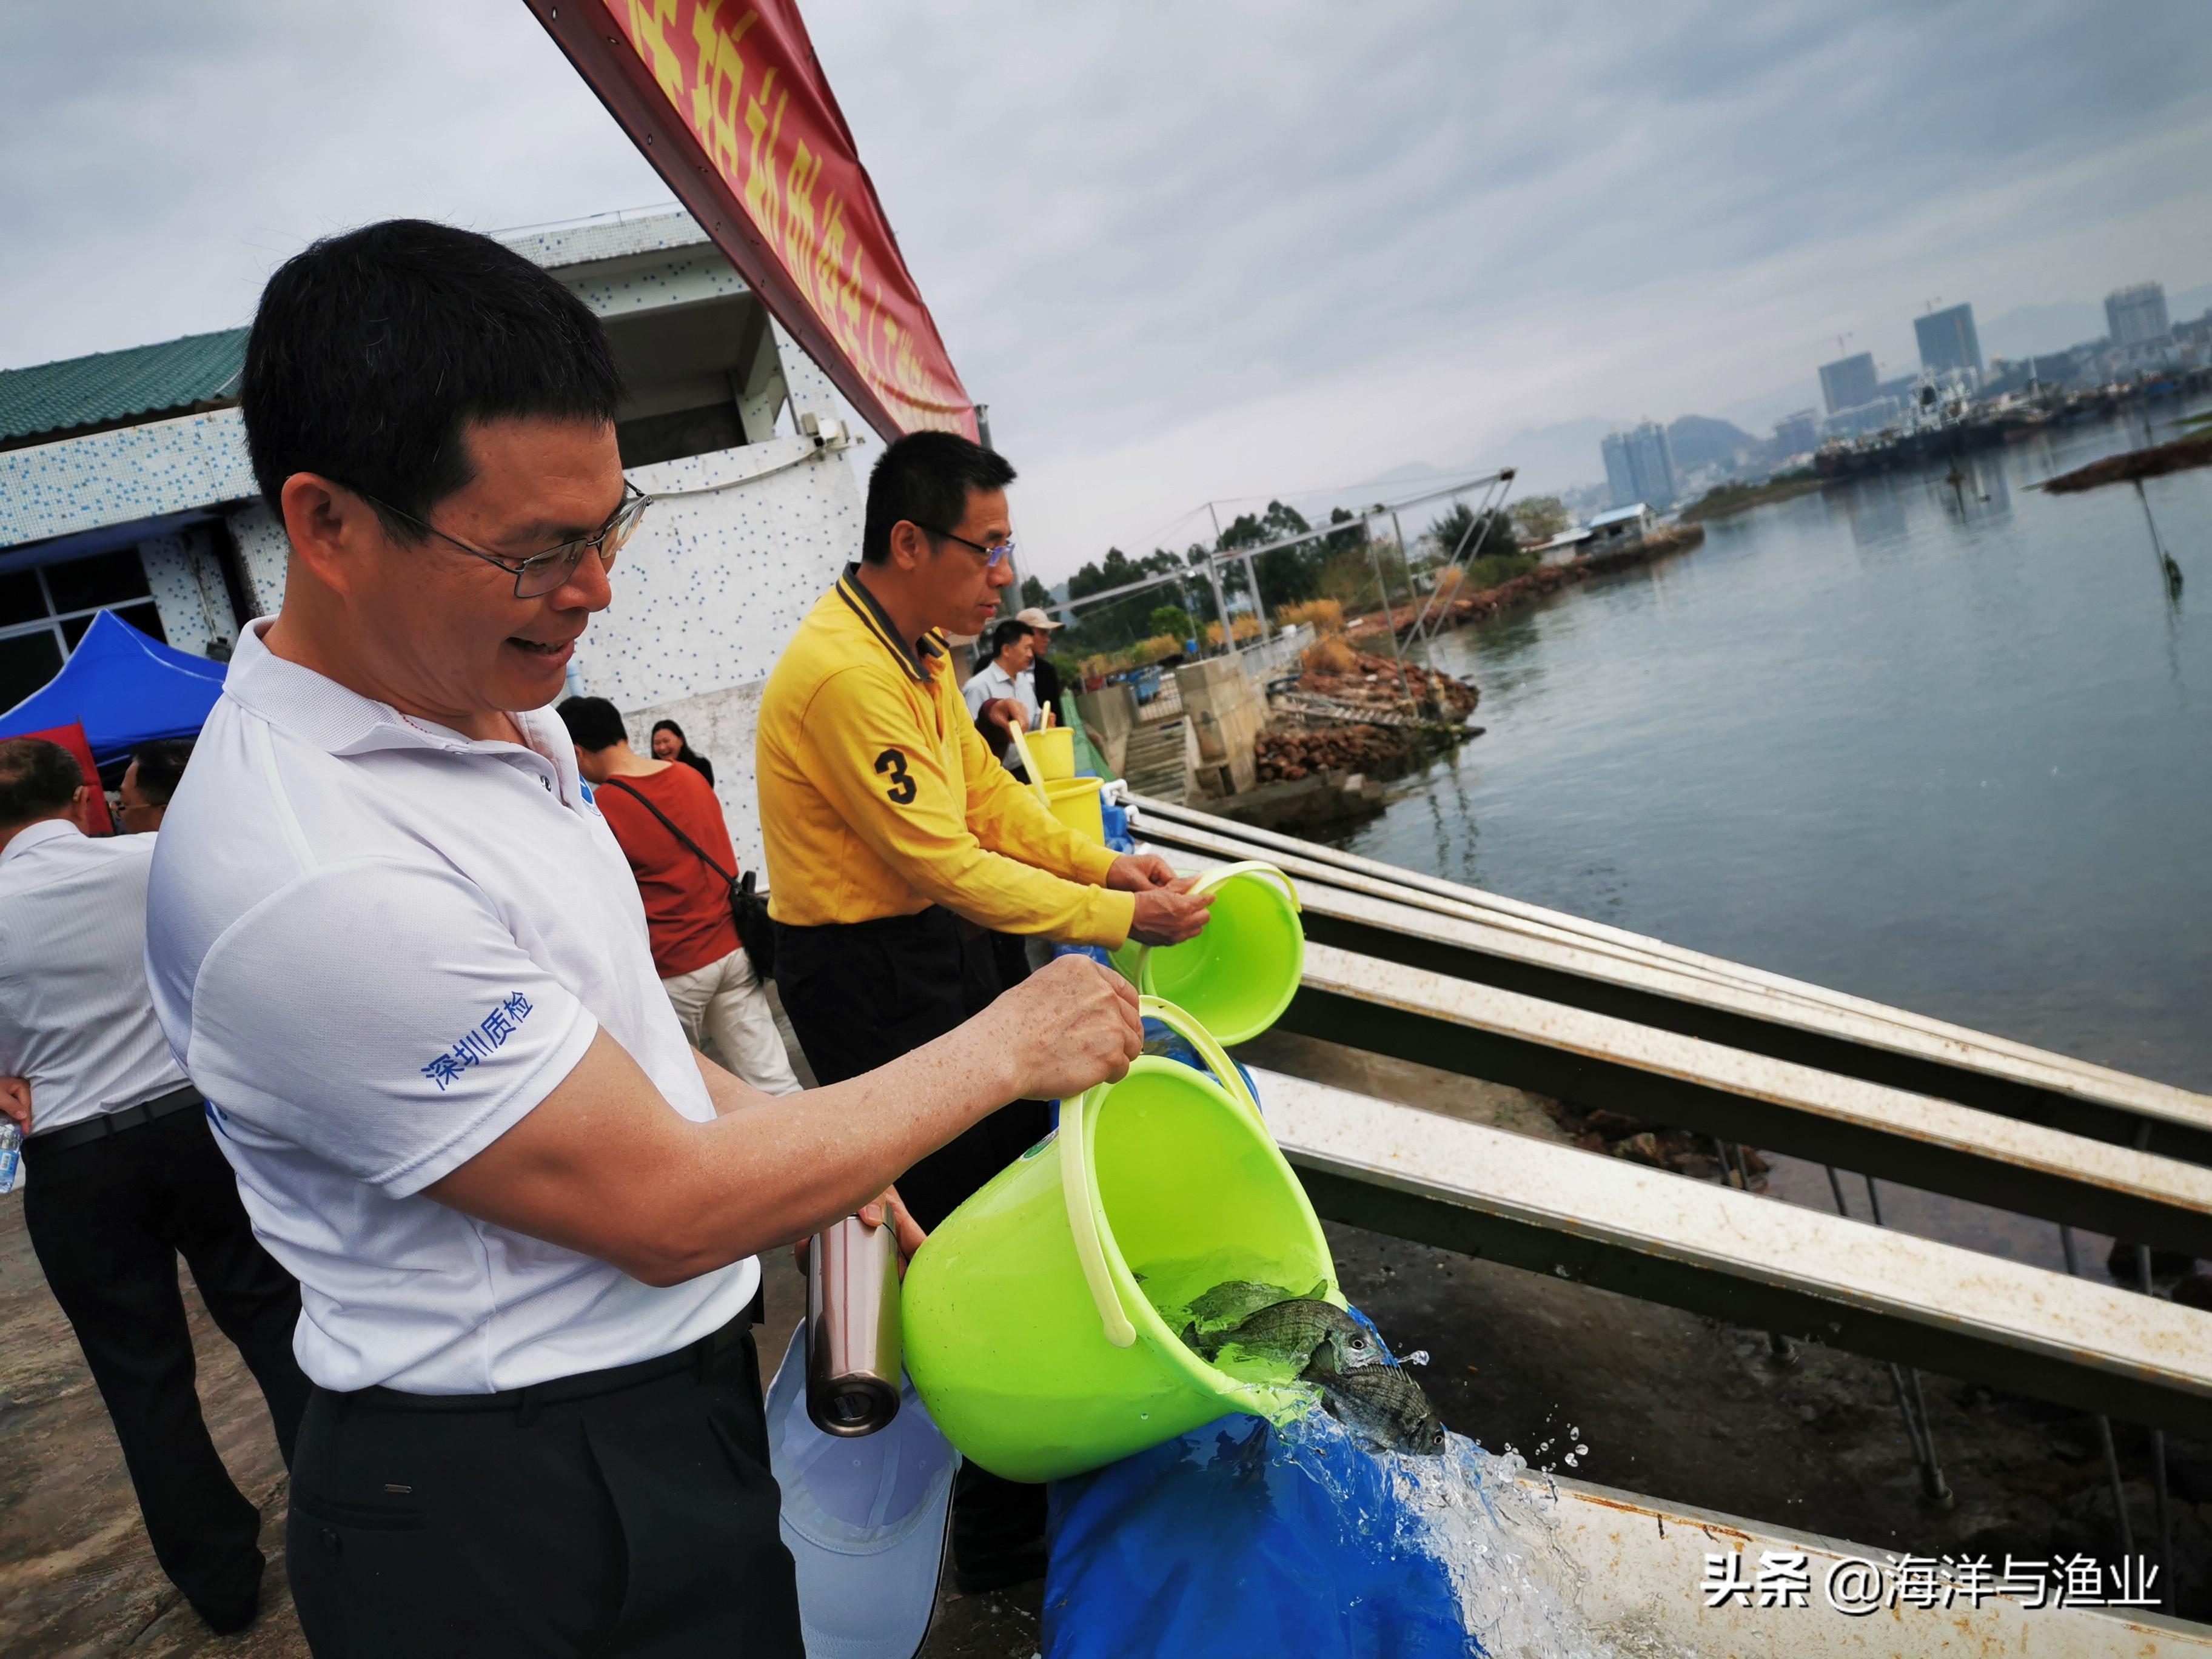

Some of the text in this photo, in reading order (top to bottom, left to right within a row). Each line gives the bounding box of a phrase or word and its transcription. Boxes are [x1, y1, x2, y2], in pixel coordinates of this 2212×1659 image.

[874, 748, 917, 805] 3
[421, 991, 533, 1091] 深圳质检
